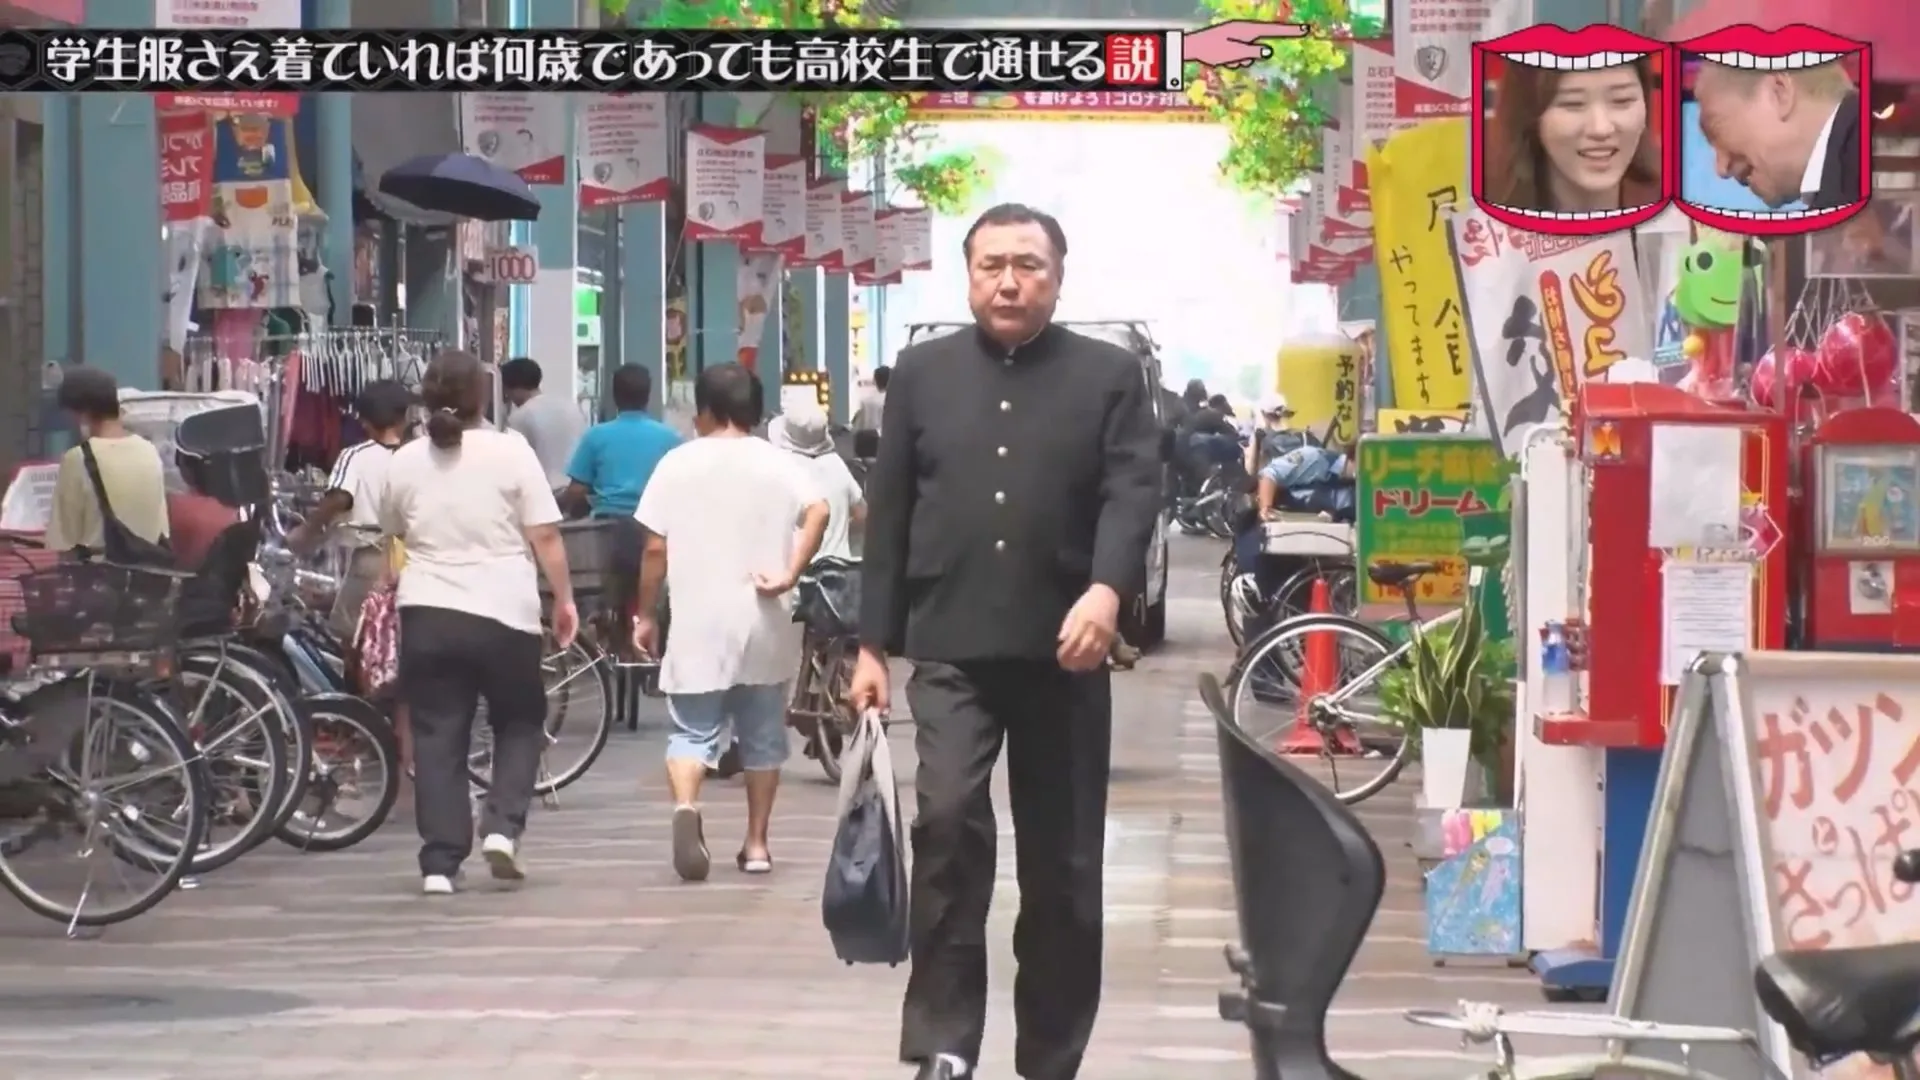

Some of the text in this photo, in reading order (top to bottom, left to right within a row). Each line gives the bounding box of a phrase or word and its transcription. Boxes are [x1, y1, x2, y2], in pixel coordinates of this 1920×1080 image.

[1390, 245, 1431, 404] やってます
[1373, 488, 1491, 518] ドリーム
